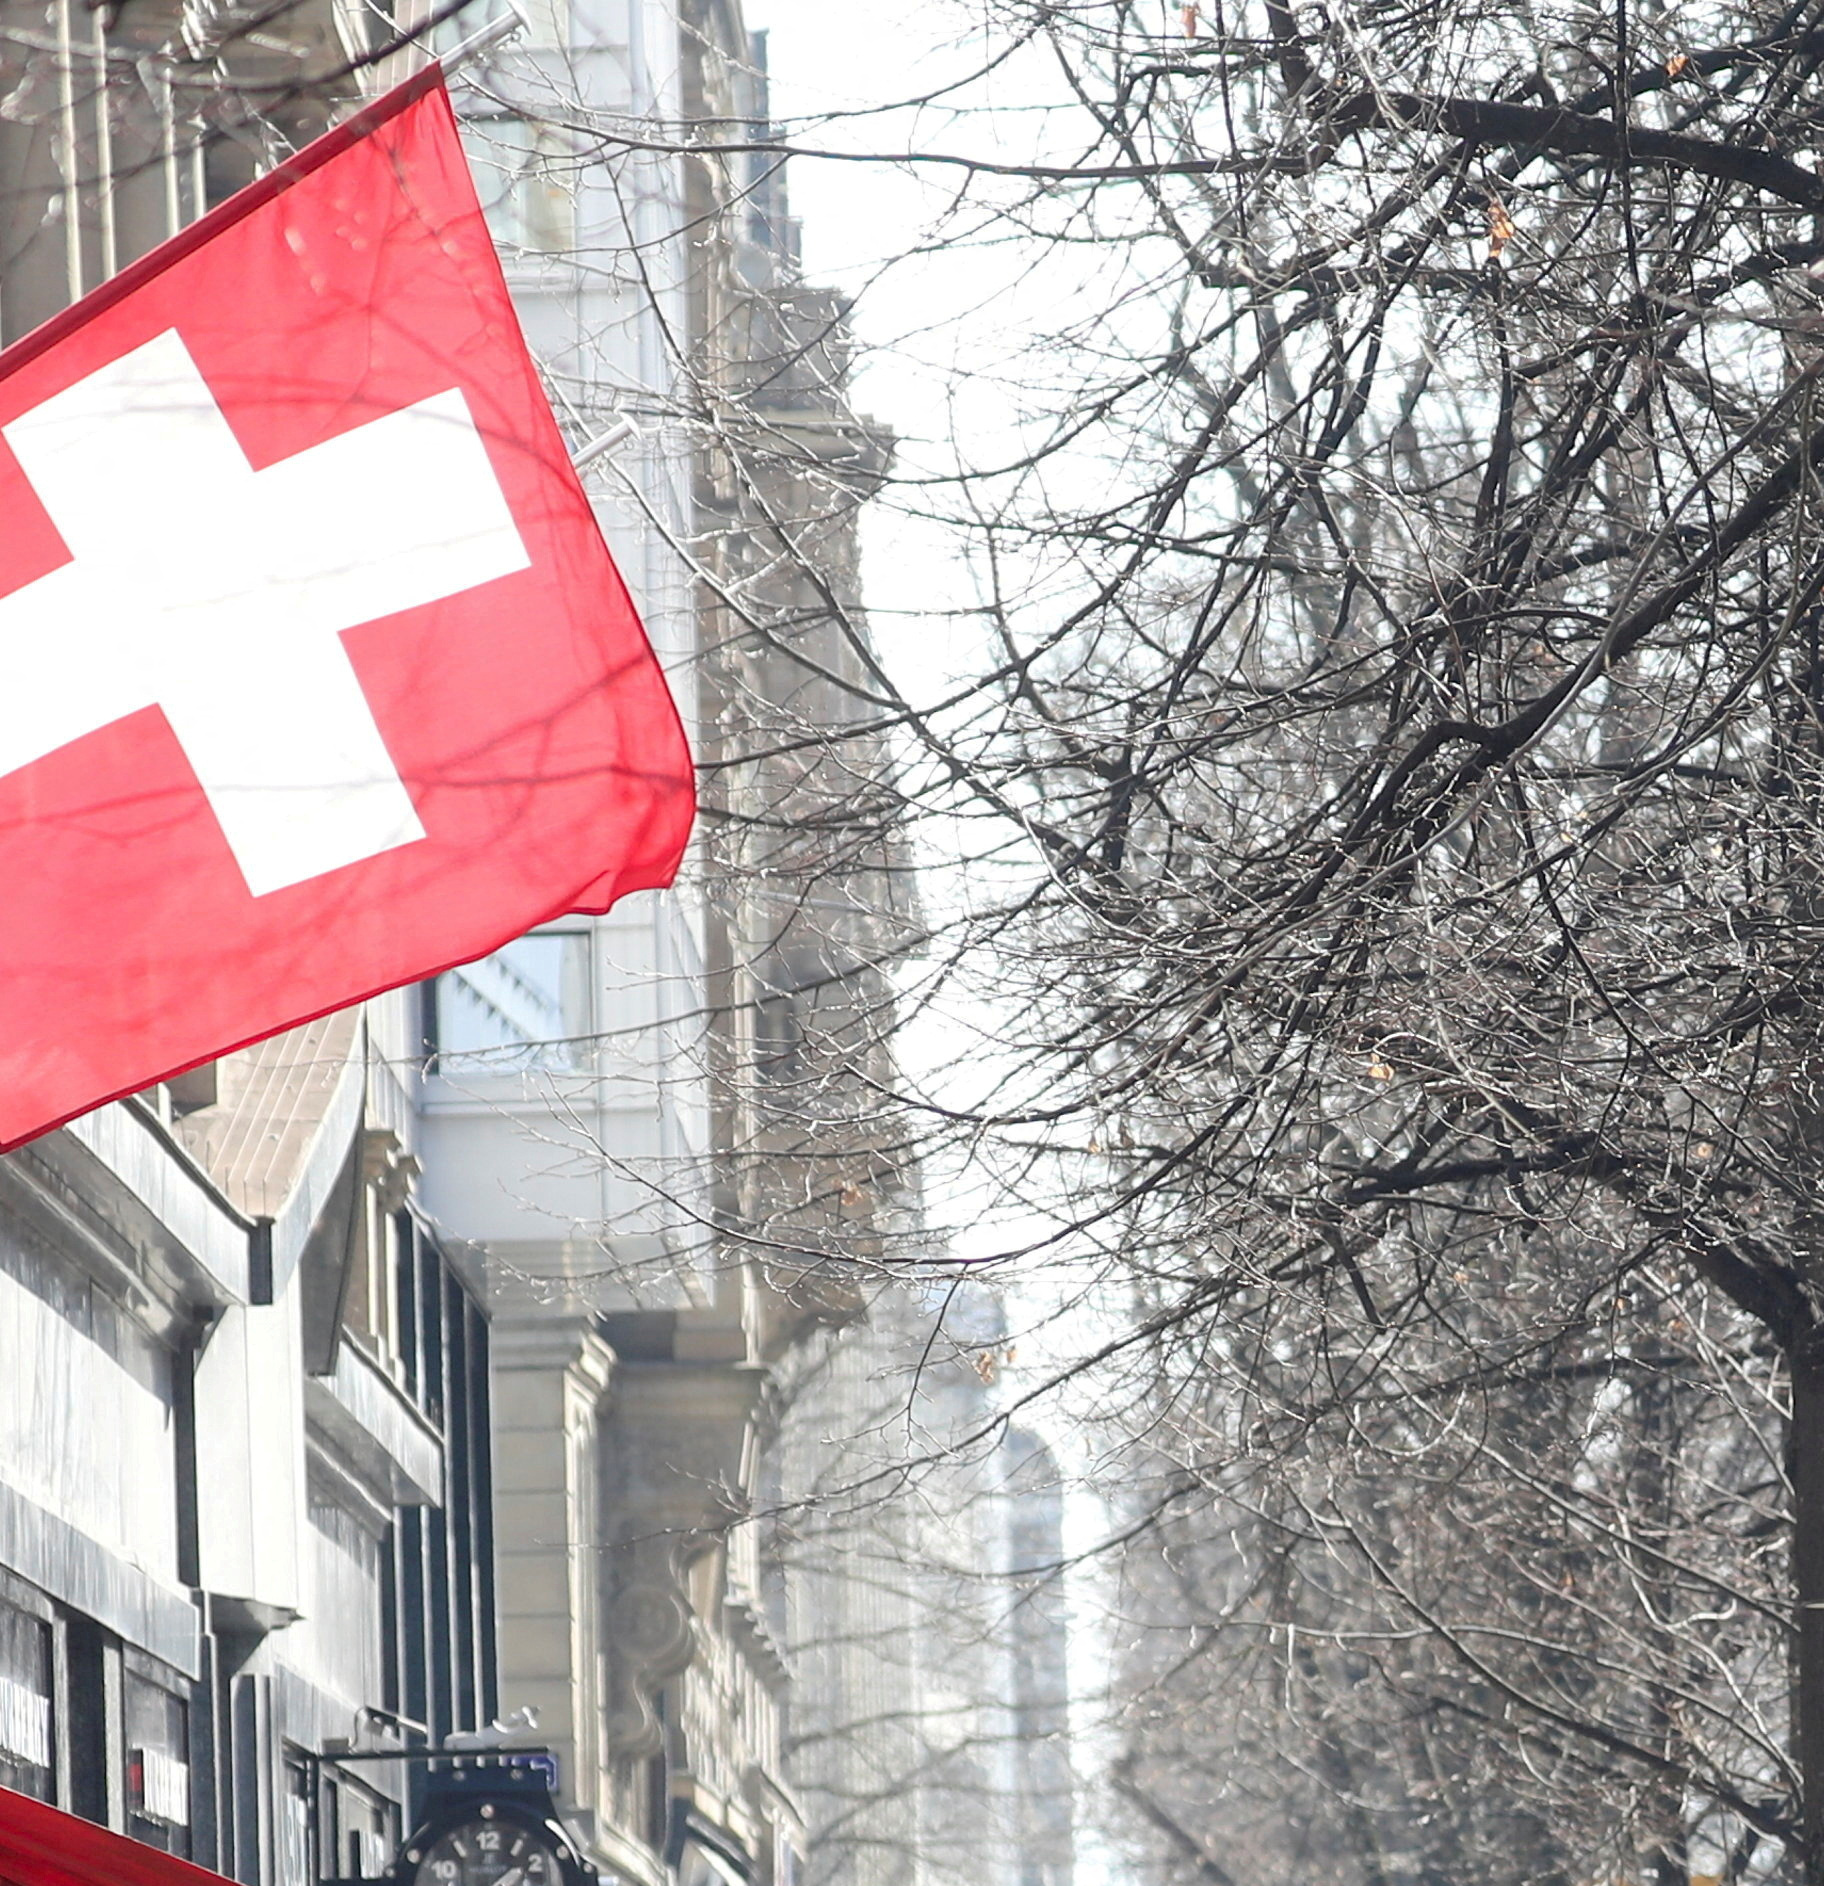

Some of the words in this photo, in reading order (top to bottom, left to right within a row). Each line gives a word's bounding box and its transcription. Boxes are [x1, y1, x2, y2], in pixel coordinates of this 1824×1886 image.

[476, 1831, 500, 1850] 12
[432, 1861, 457, 1878] 10
[528, 1854, 543, 1872] 2
